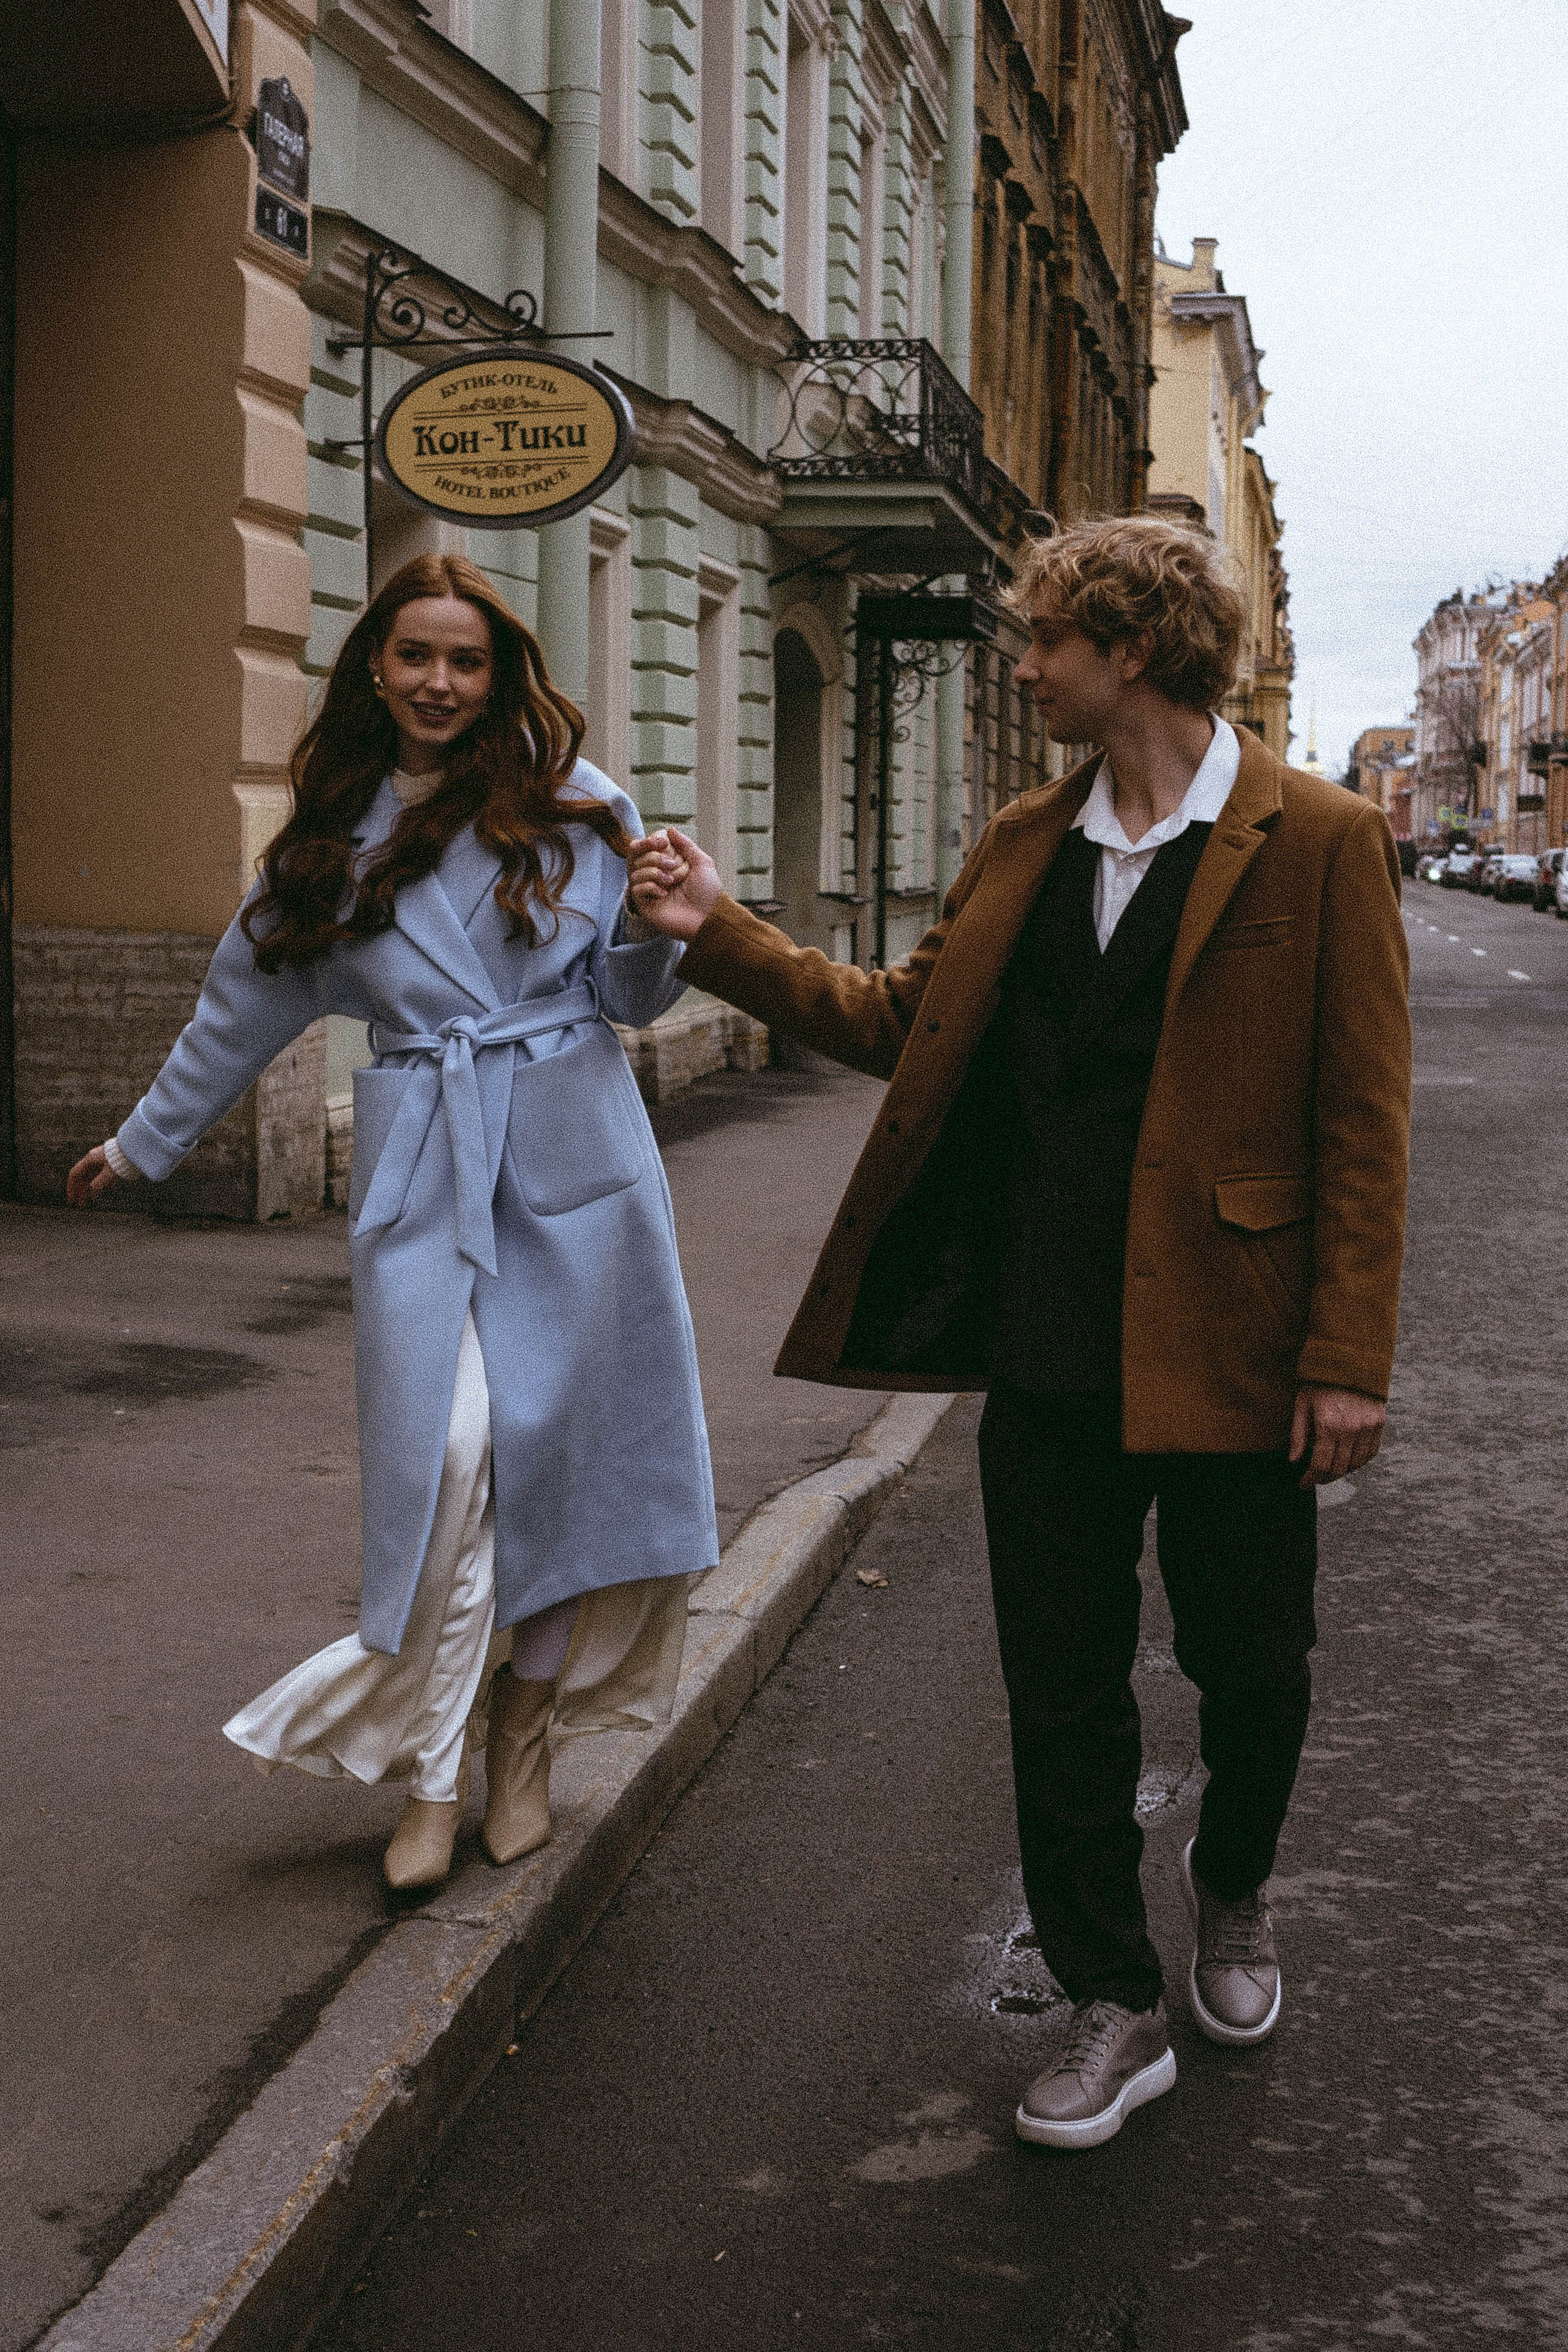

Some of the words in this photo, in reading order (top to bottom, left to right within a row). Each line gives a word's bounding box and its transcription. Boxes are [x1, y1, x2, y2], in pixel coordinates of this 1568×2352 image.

[440, 374, 558, 399] БУТИК-ОТЕЛЬ
[413, 421, 587, 456] Кон-Тики
[434, 475, 486, 499] HOTEL
[490, 467, 571, 499] BOUTIQUE
